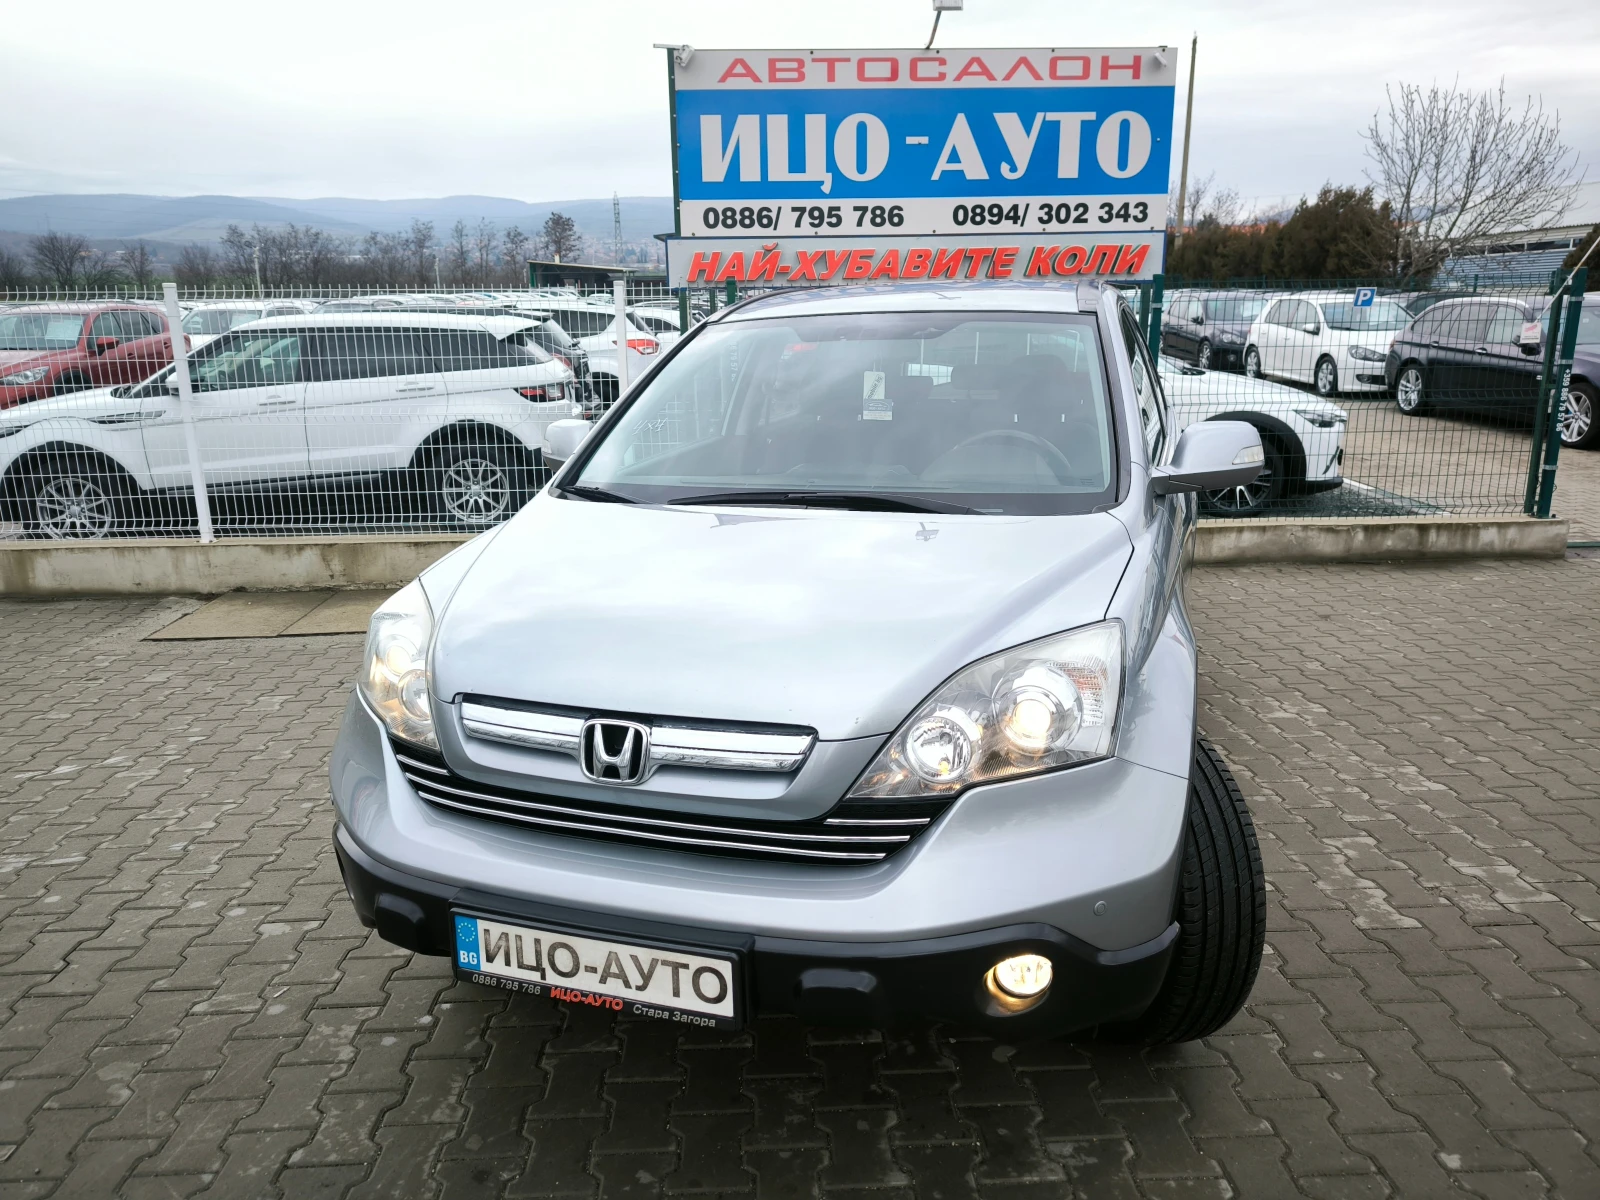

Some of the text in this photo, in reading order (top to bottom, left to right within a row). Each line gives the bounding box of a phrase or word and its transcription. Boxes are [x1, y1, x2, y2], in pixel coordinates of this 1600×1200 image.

[717, 55, 1142, 83] АВТОСАЛОН
[703, 205, 904, 231] 0886/ 795 786
[953, 202, 1149, 227] 0894/ 302 343
[687, 241, 1151, 282] НАЙ-ХУБАВИТЕ КОЛИ
[1356, 290, 1372, 306] P
[459, 950, 478, 965] BG
[483, 928, 728, 1005] ИЦО-АУТО
[472, 974, 541, 995] 0886 795 786
[550, 986, 624, 1011] ИЦО-АУТО
[632, 1004, 717, 1028] Стара Загора
